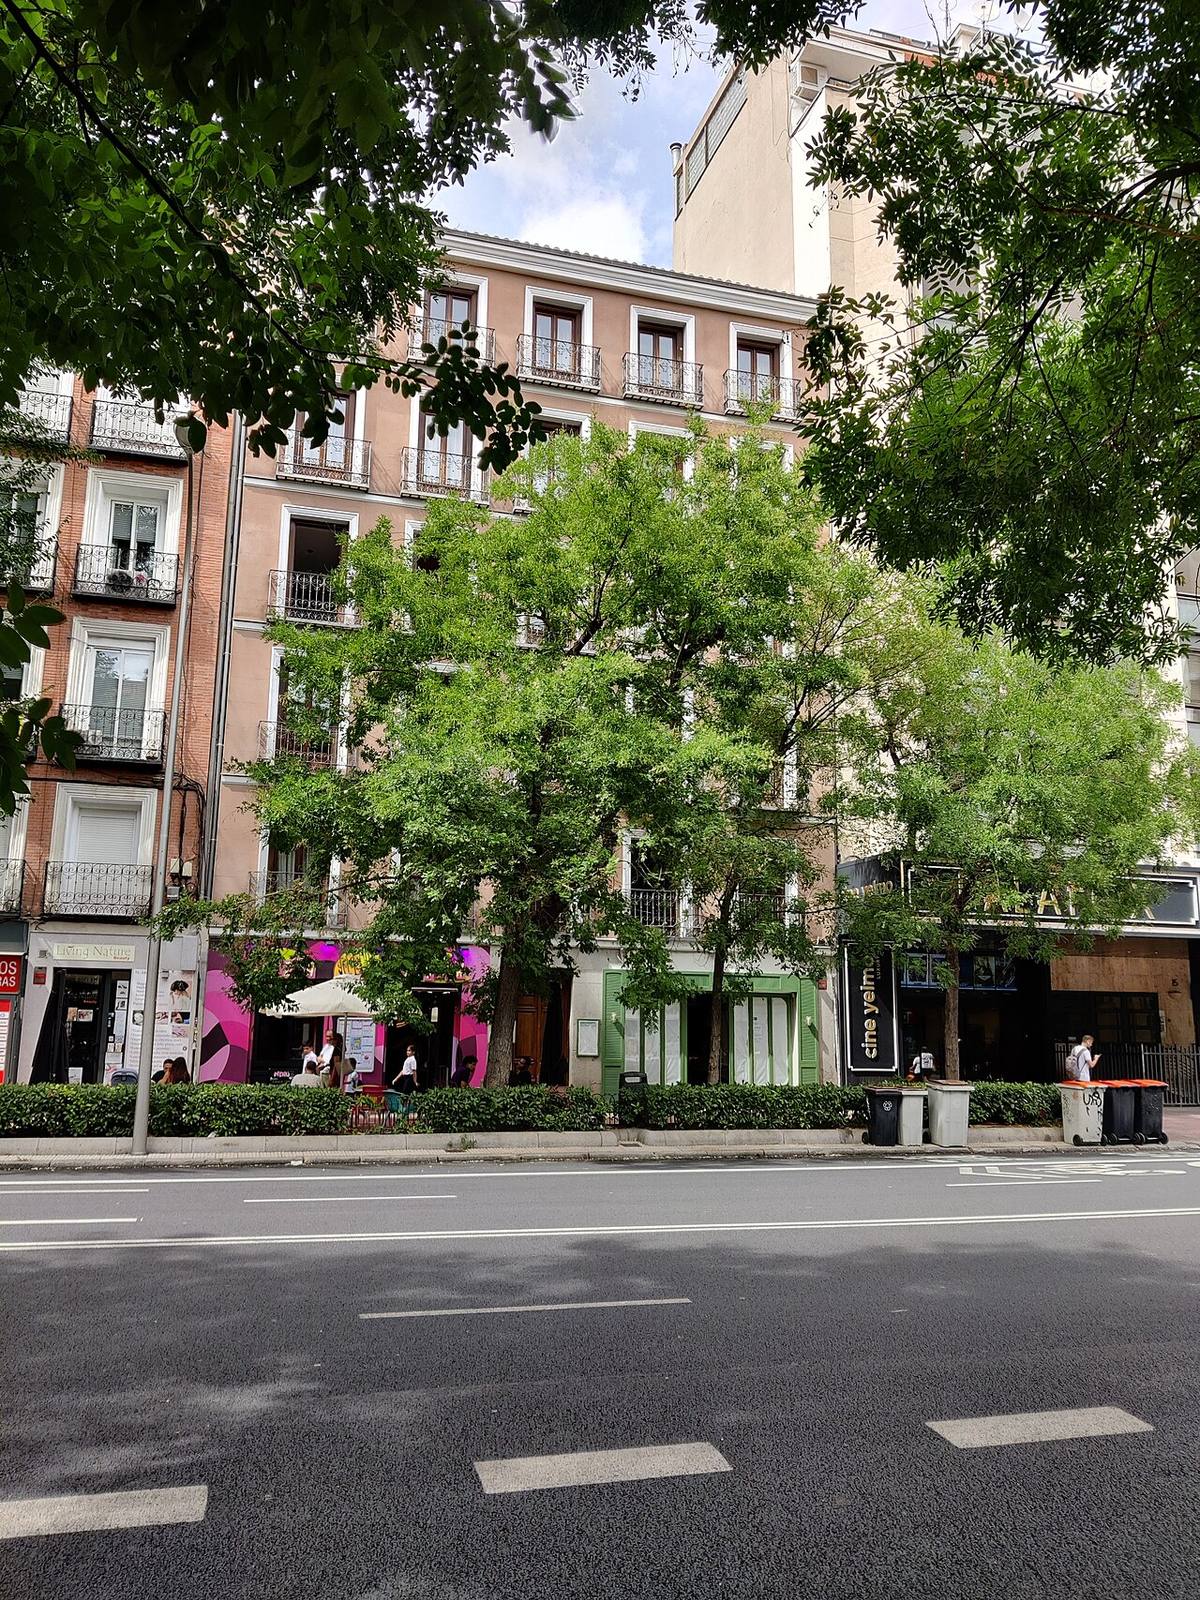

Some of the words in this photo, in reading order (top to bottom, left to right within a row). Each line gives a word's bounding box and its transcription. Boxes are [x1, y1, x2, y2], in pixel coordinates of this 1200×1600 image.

[56, 944, 89, 958] Living
[94, 944, 131, 957] Nature
[859, 955, 879, 1015] yelmo
[861, 1018, 878, 1059] cine
